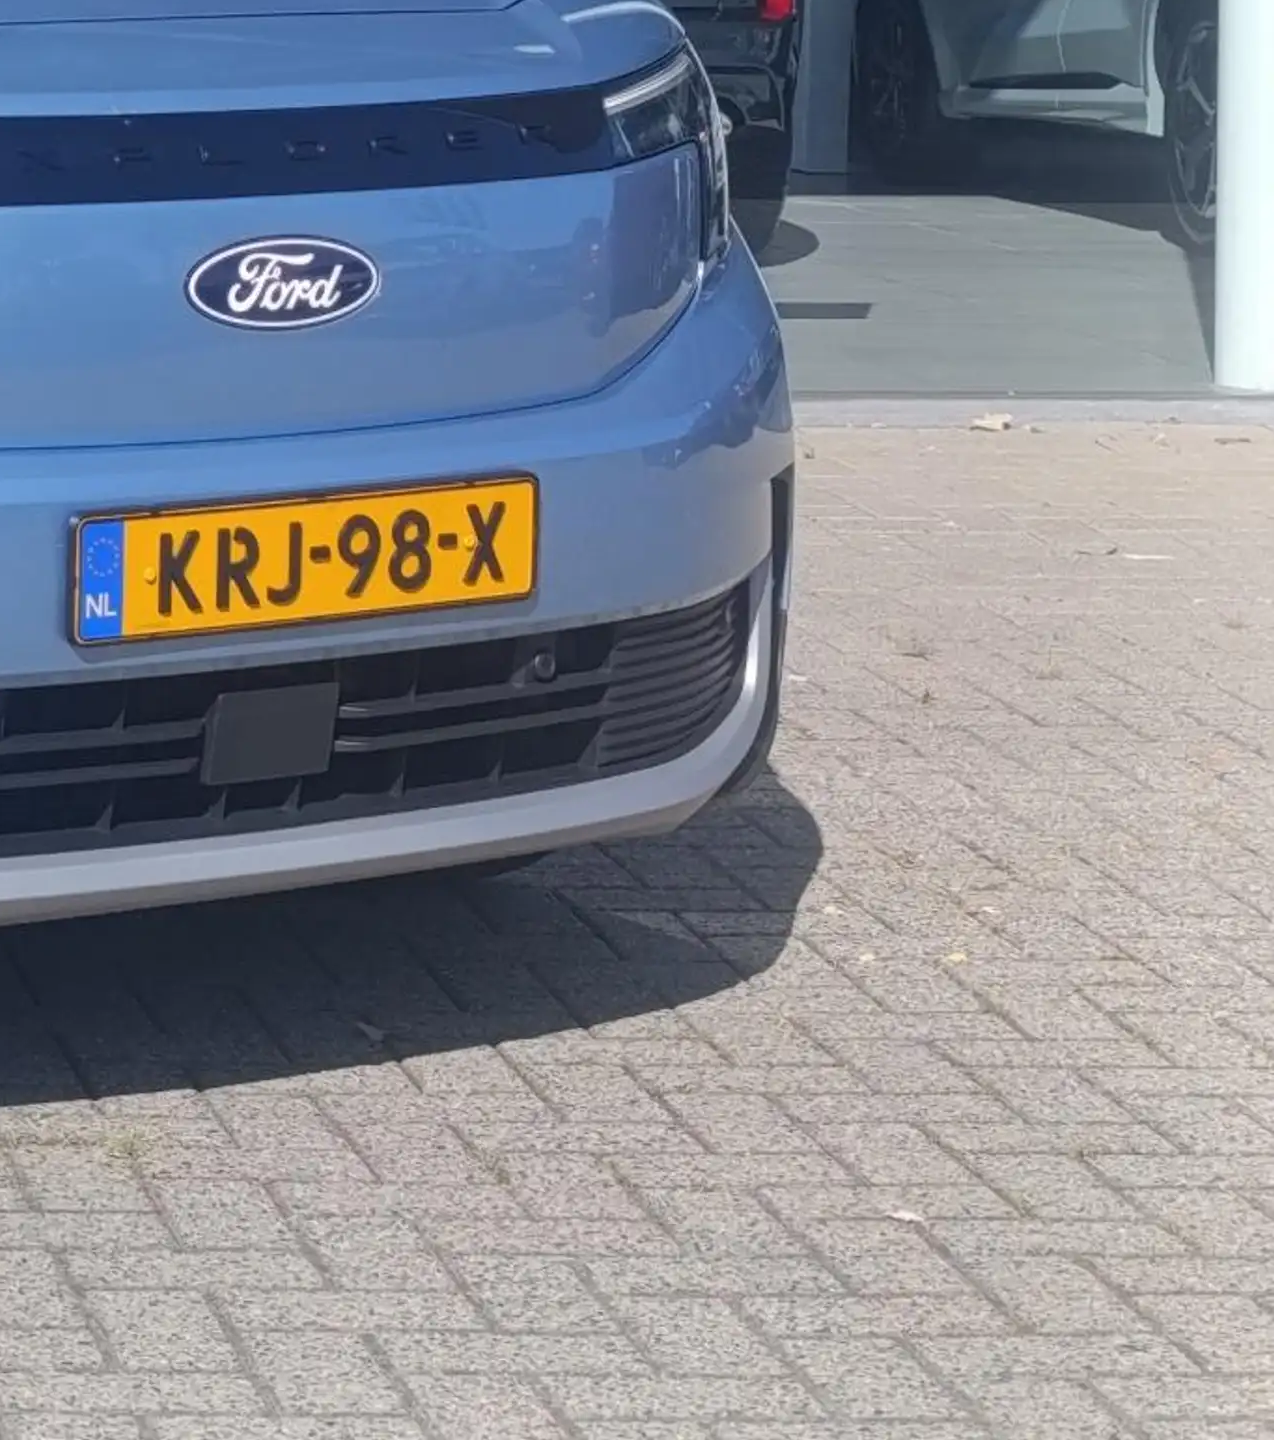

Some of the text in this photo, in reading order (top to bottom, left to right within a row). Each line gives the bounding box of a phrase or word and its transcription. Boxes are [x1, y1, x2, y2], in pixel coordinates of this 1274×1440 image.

[226, 252, 344, 312] Ford
[157, 500, 506, 617] KRJ-98-X
[85, 592, 118, 620] NL
